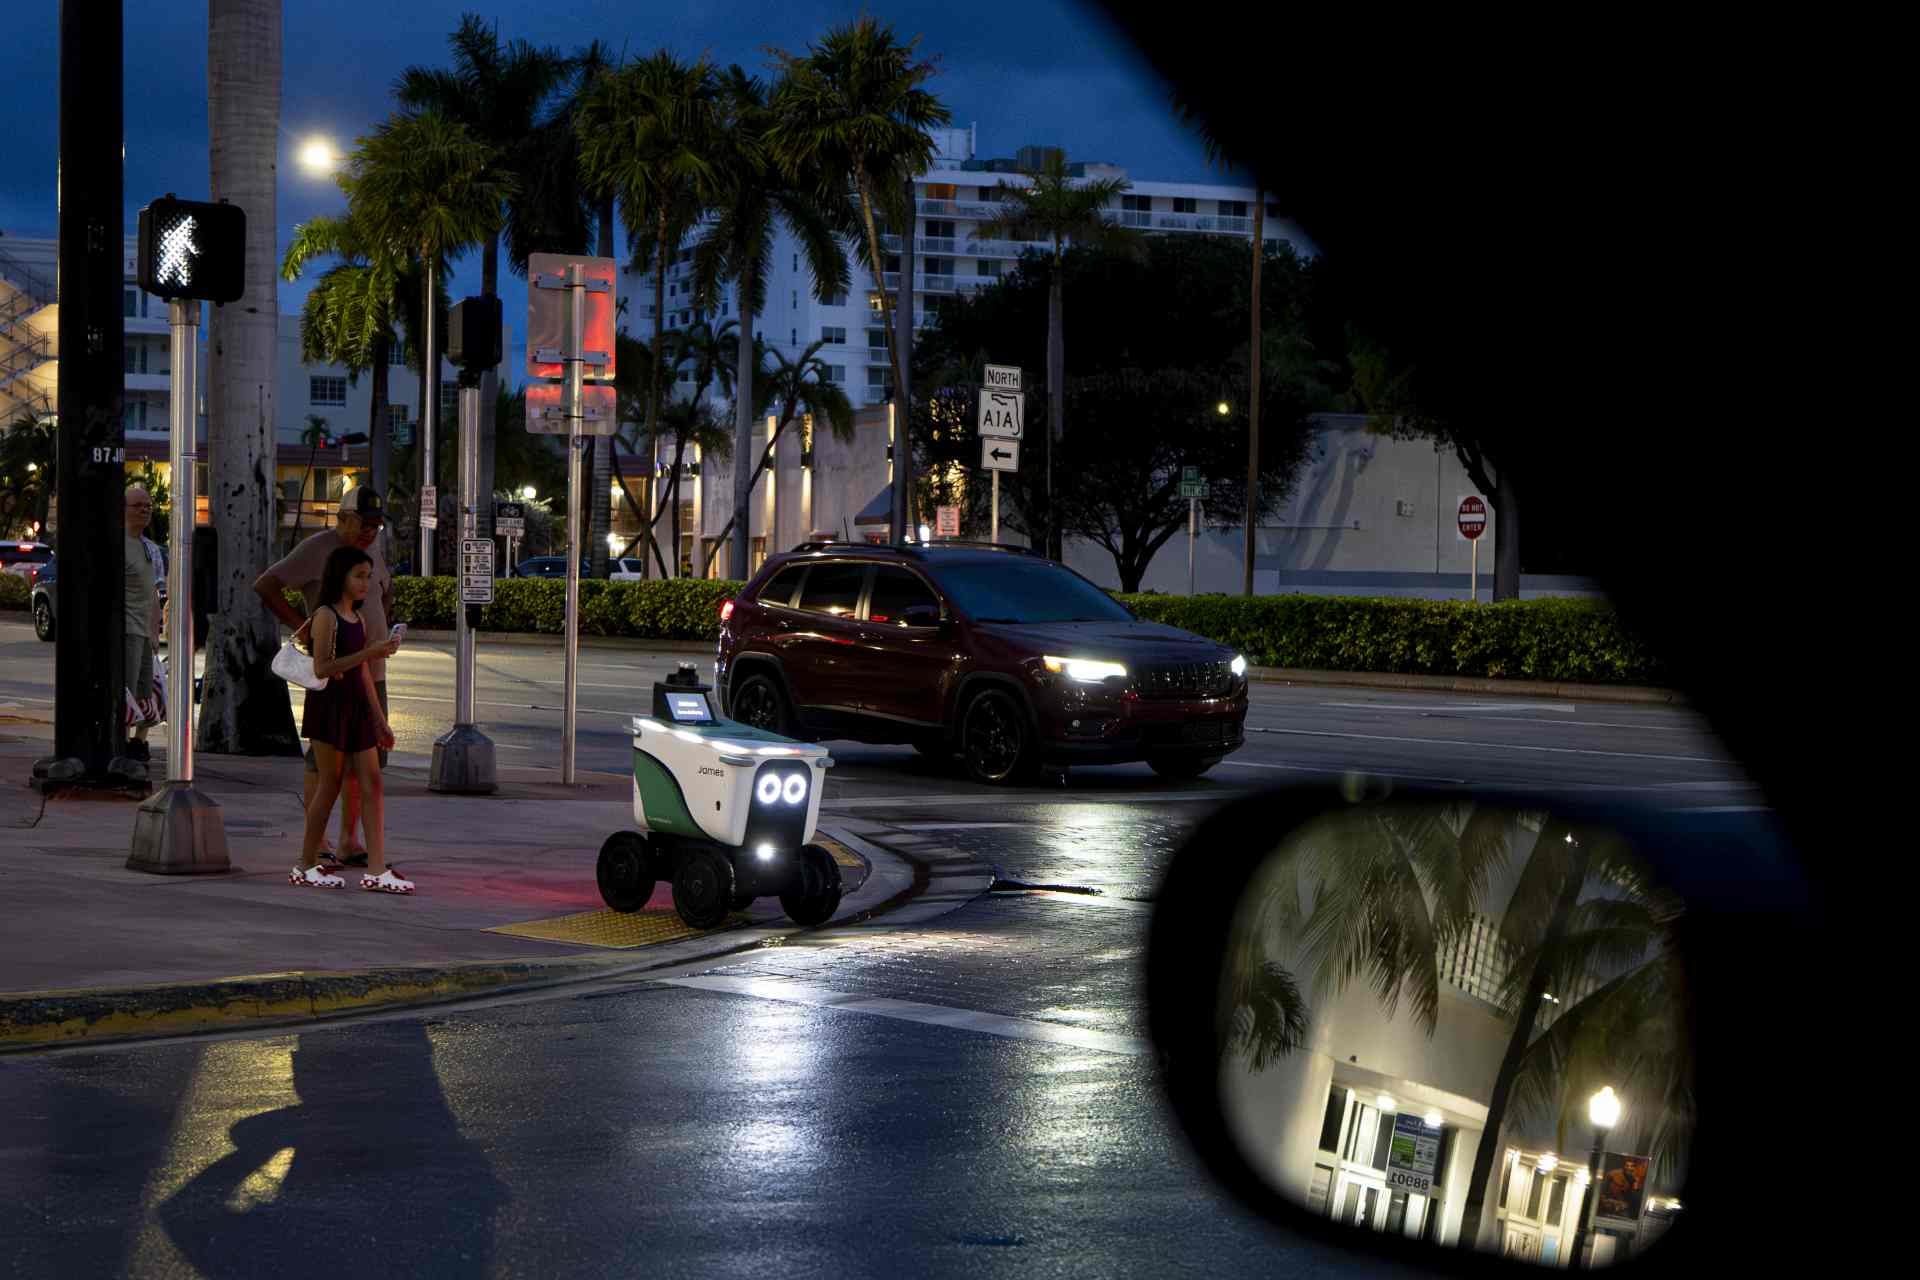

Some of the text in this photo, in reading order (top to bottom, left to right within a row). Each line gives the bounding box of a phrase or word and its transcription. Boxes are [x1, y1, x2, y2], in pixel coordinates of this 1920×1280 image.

[987, 369, 1019, 386] NORTH
[983, 409, 1013, 428] A1A
[1461, 504, 1483, 513] DO NOT
[1462, 523, 1482, 532] ENTER
[697, 762, 724, 777] James
